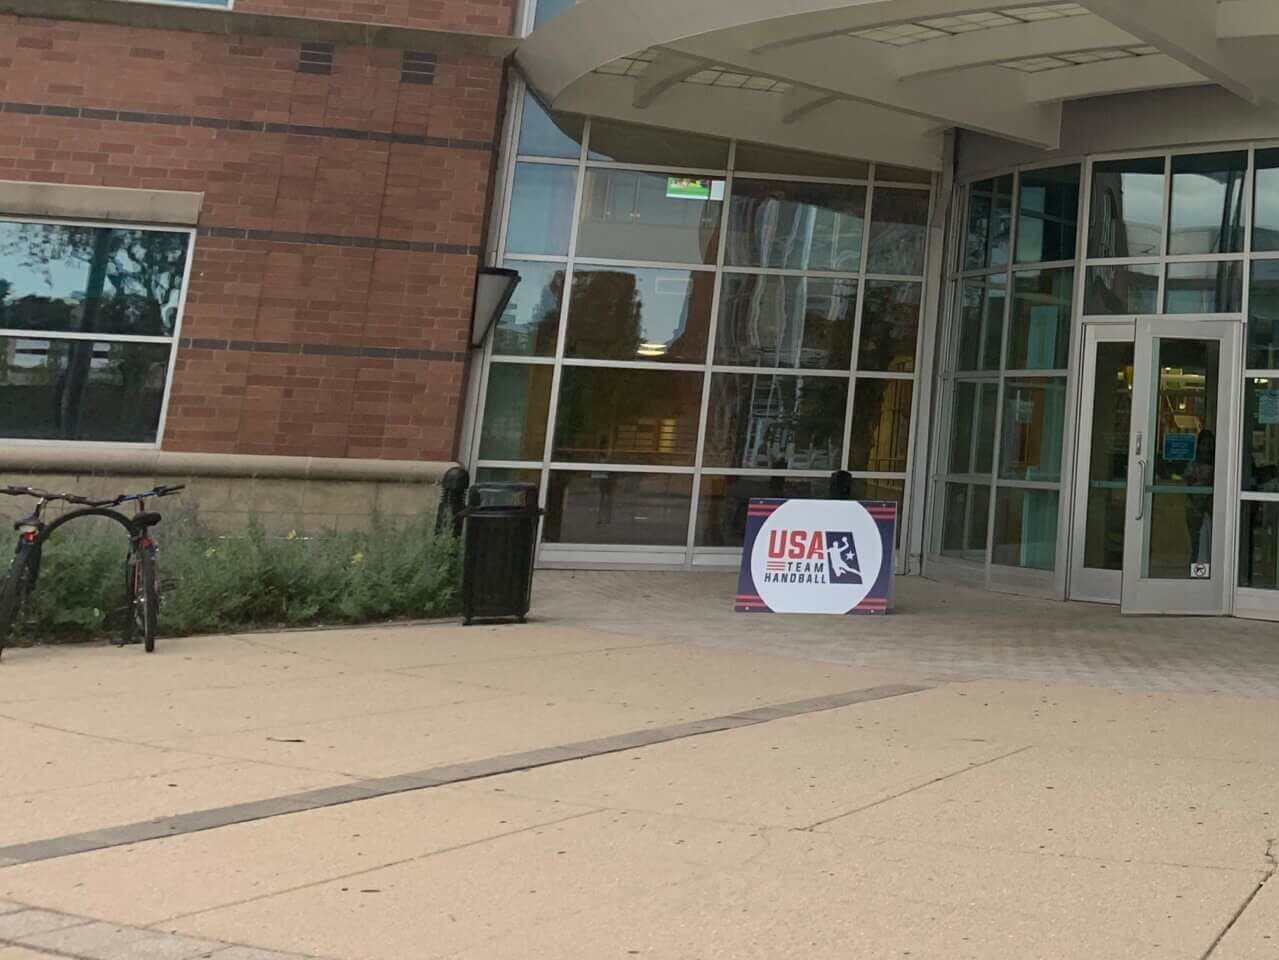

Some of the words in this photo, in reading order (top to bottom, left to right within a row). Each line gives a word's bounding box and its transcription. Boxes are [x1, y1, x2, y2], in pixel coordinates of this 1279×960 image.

[767, 529, 824, 560] USA
[787, 561, 824, 572] TEAM
[764, 572, 827, 585] HANDBALL
